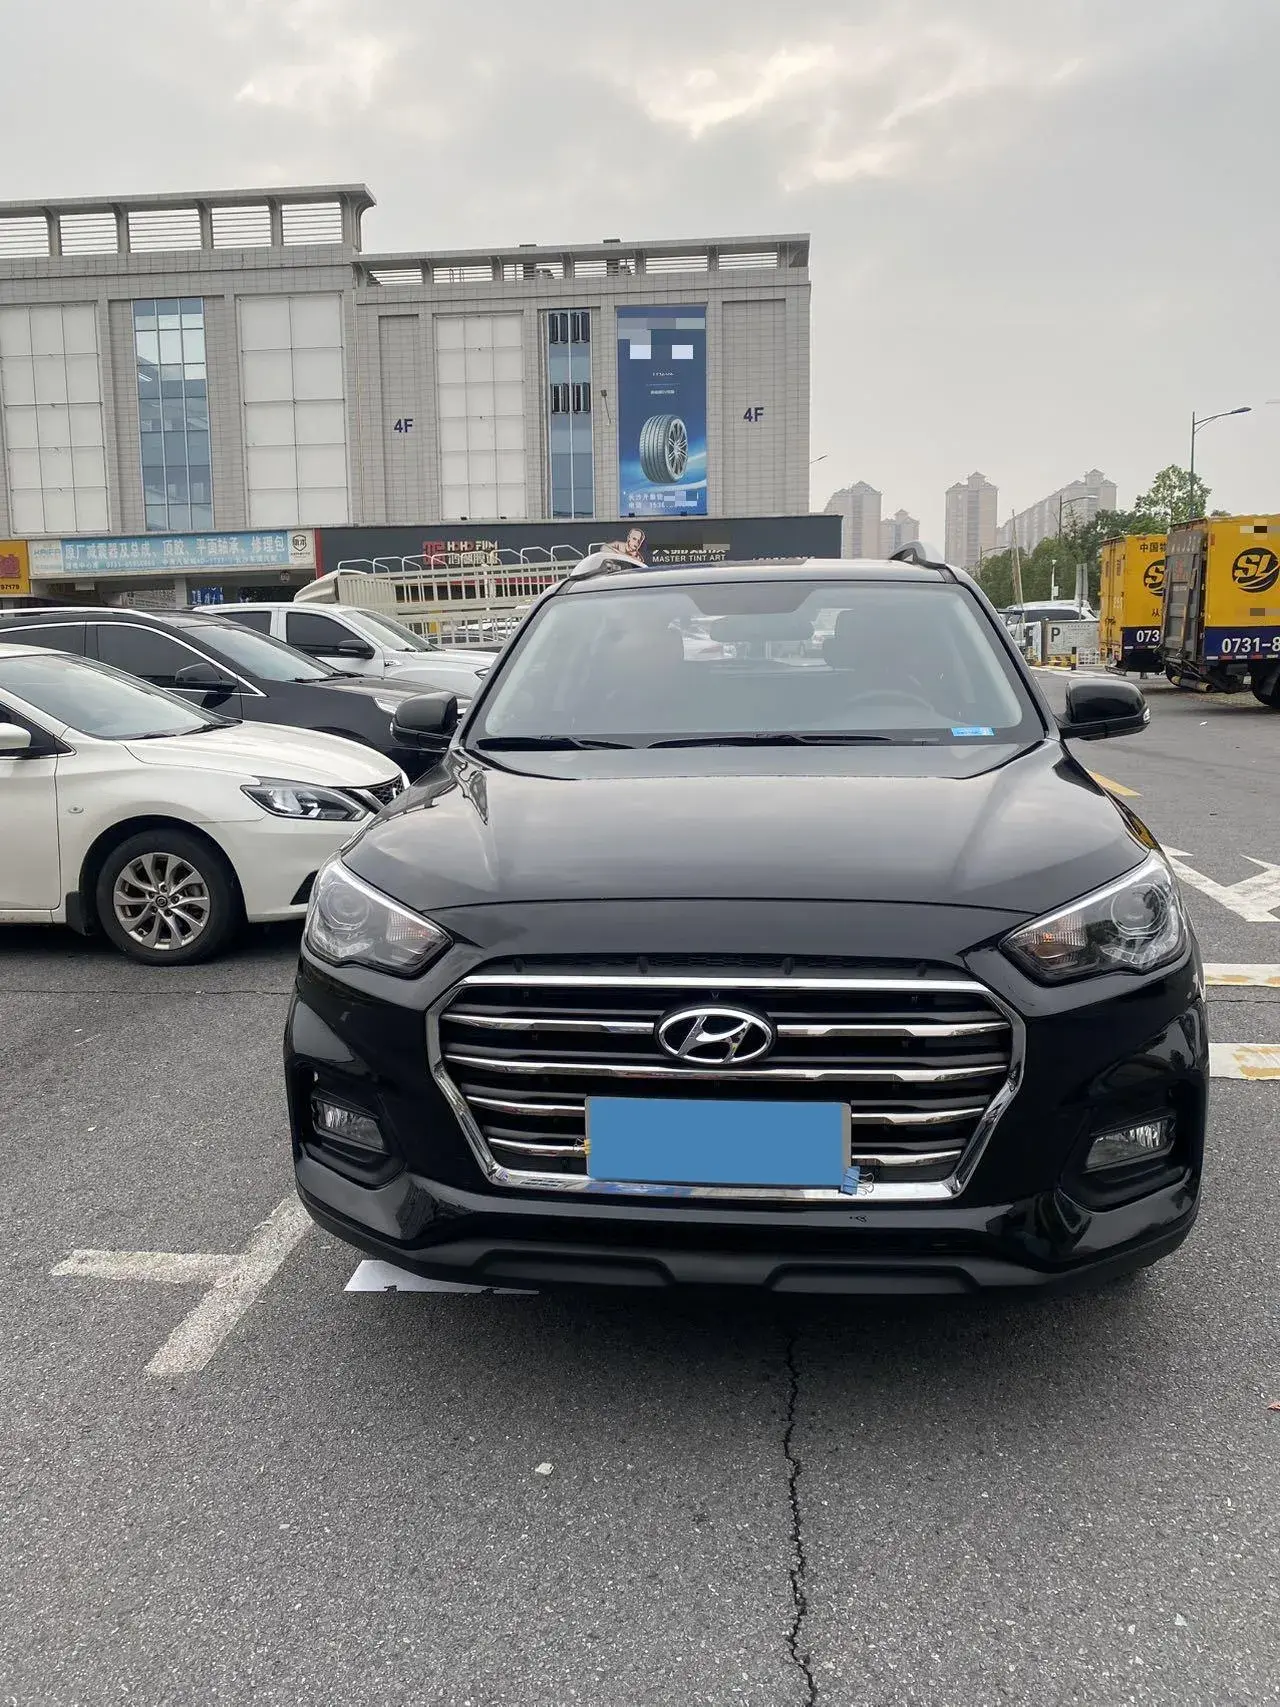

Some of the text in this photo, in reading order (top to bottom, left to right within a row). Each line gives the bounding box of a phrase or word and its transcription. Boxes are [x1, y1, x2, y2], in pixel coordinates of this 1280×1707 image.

[743, 407, 765, 422] 4F
[393, 418, 414, 433] 4F
[652, 553, 726, 563] MASTER TINT ART
[1051, 627, 1061, 643] P
[1136, 630, 1160, 643] 073
[1222, 636, 1280, 653] 0731-8
